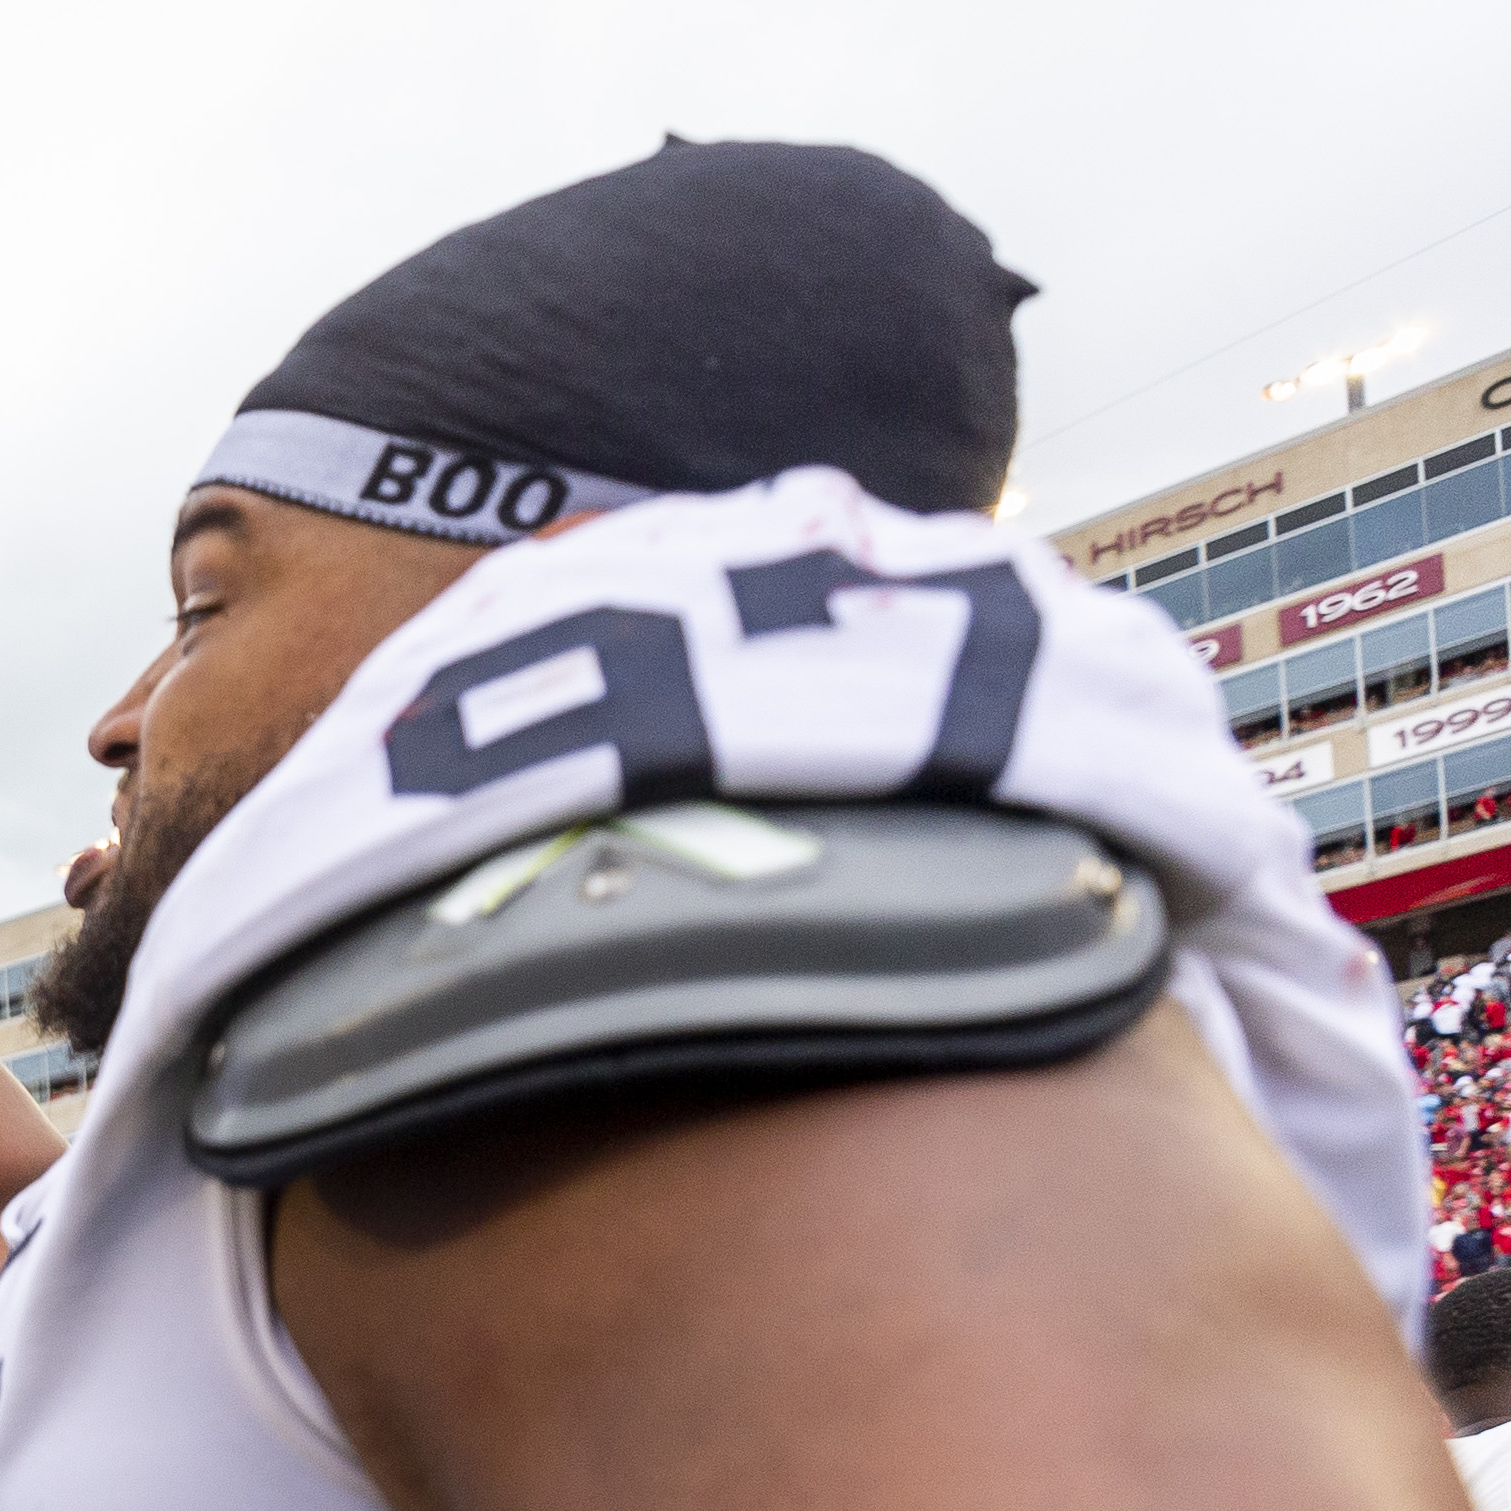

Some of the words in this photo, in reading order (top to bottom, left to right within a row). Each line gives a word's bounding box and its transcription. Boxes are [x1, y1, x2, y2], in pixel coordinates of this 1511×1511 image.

[360, 442, 570, 532] BOO
[1089, 469, 1286, 565] HIRSCH
[1299, 569, 1419, 629] 1962
